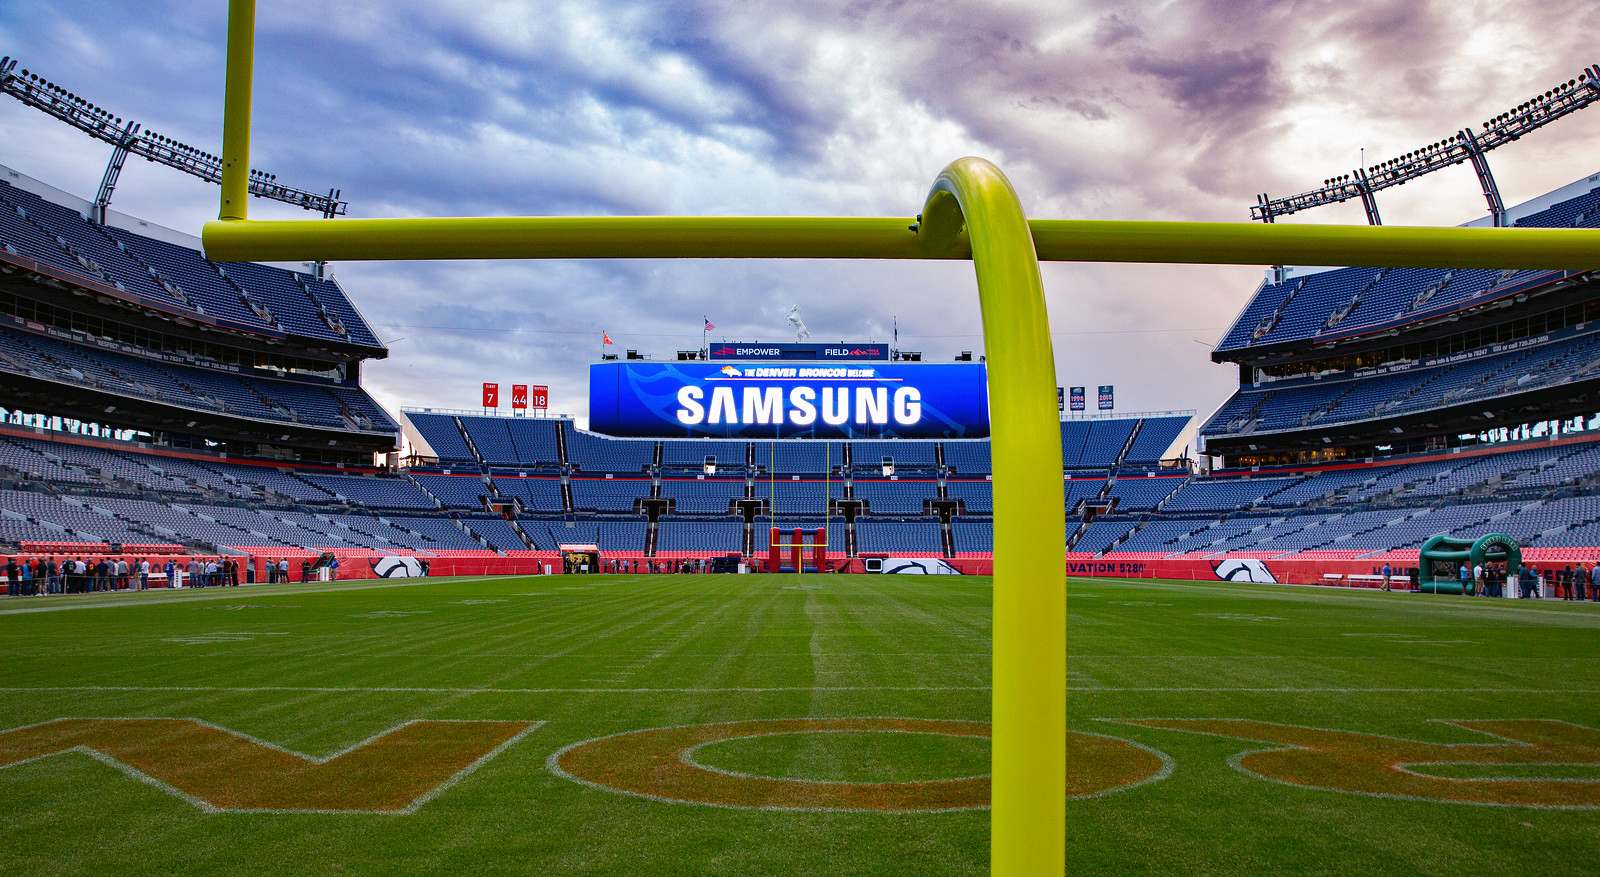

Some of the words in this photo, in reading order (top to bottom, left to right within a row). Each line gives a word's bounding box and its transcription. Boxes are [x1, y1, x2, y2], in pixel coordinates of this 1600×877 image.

[736, 348, 780, 356] EMPOWER
[825, 348, 849, 356] FIELD
[1450, 353, 1467, 361] location
[744, 368, 756, 378] THE
[756, 368, 797, 378] DENVER
[798, 368, 847, 378] BRONCOS
[847, 369, 875, 378] WELCOME
[487, 394, 494, 404] 7
[513, 395, 527, 406] 44
[535, 396, 546, 406] 18
[676, 385, 921, 425] SAMSUNG
